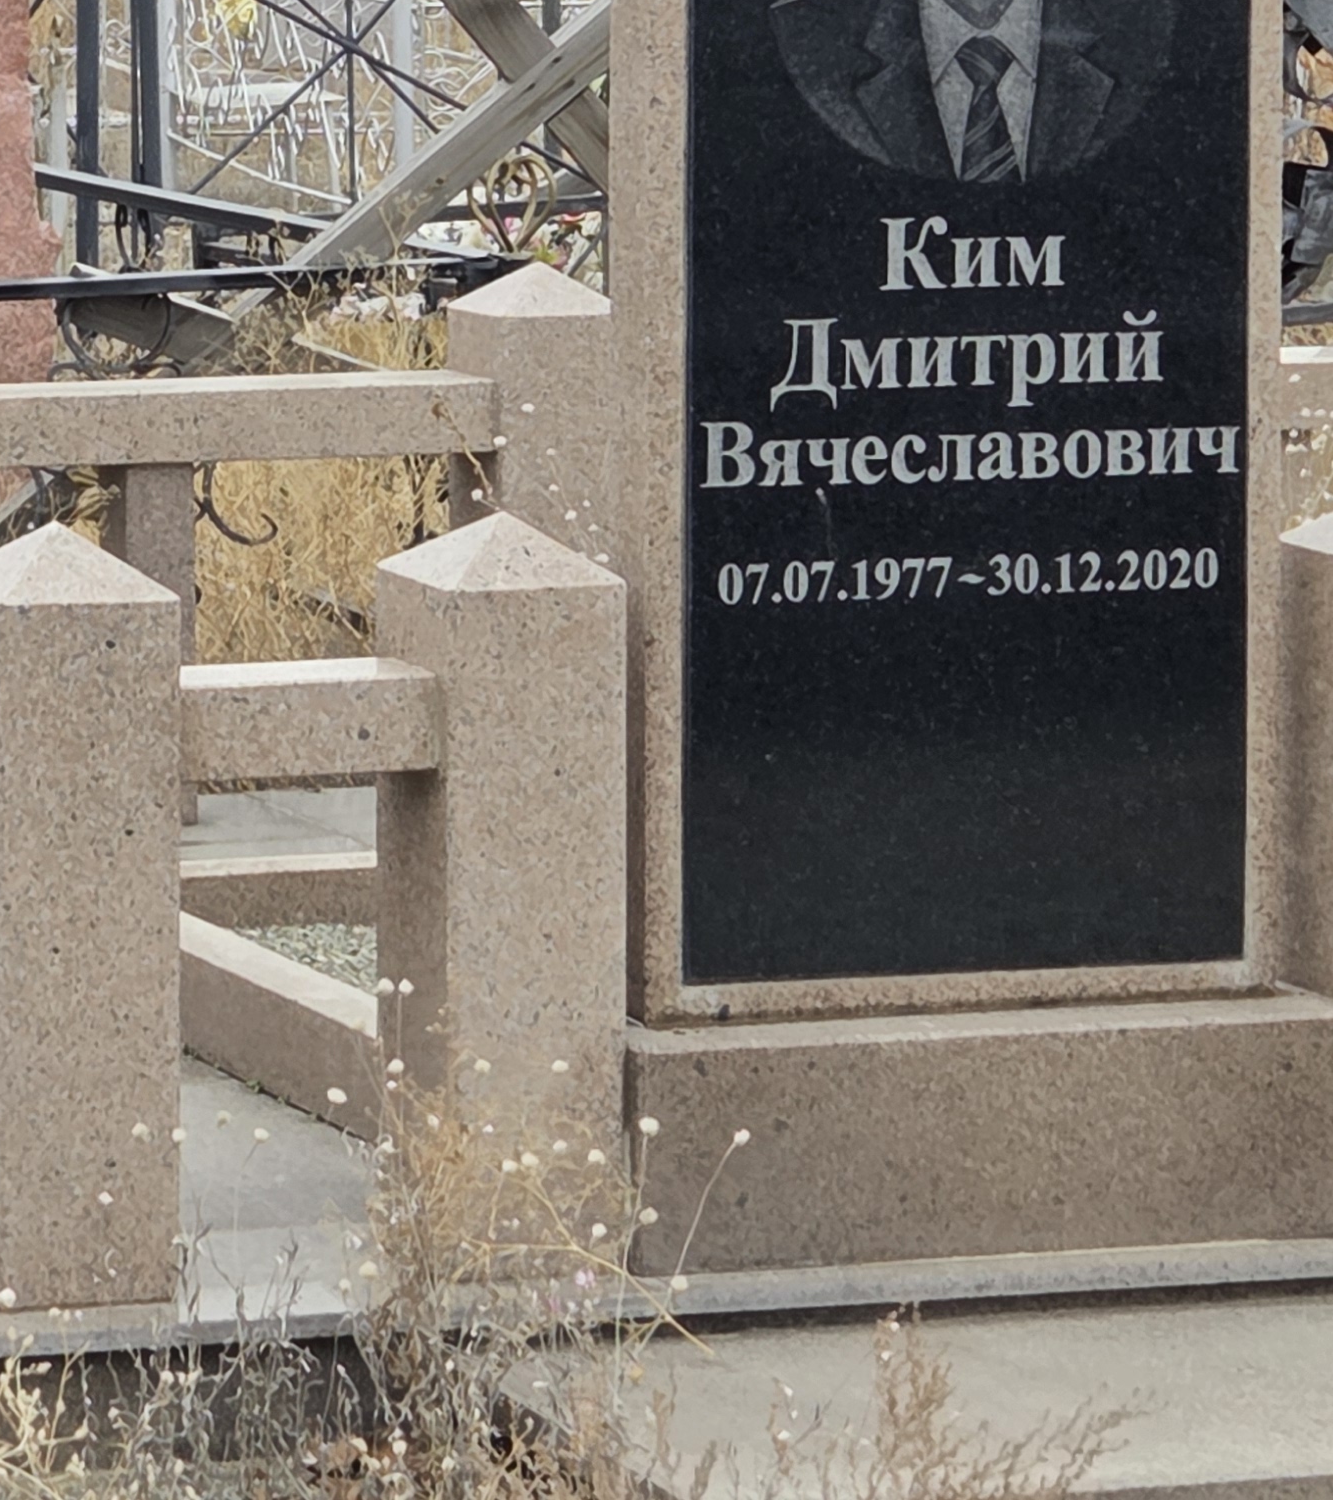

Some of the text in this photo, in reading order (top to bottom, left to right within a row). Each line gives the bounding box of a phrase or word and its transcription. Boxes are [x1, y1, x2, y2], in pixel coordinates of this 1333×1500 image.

[879, 215, 1066, 291] Ким
[769, 309, 1165, 412] Дмитрий
[699, 420, 1241, 489] Вячеславович
